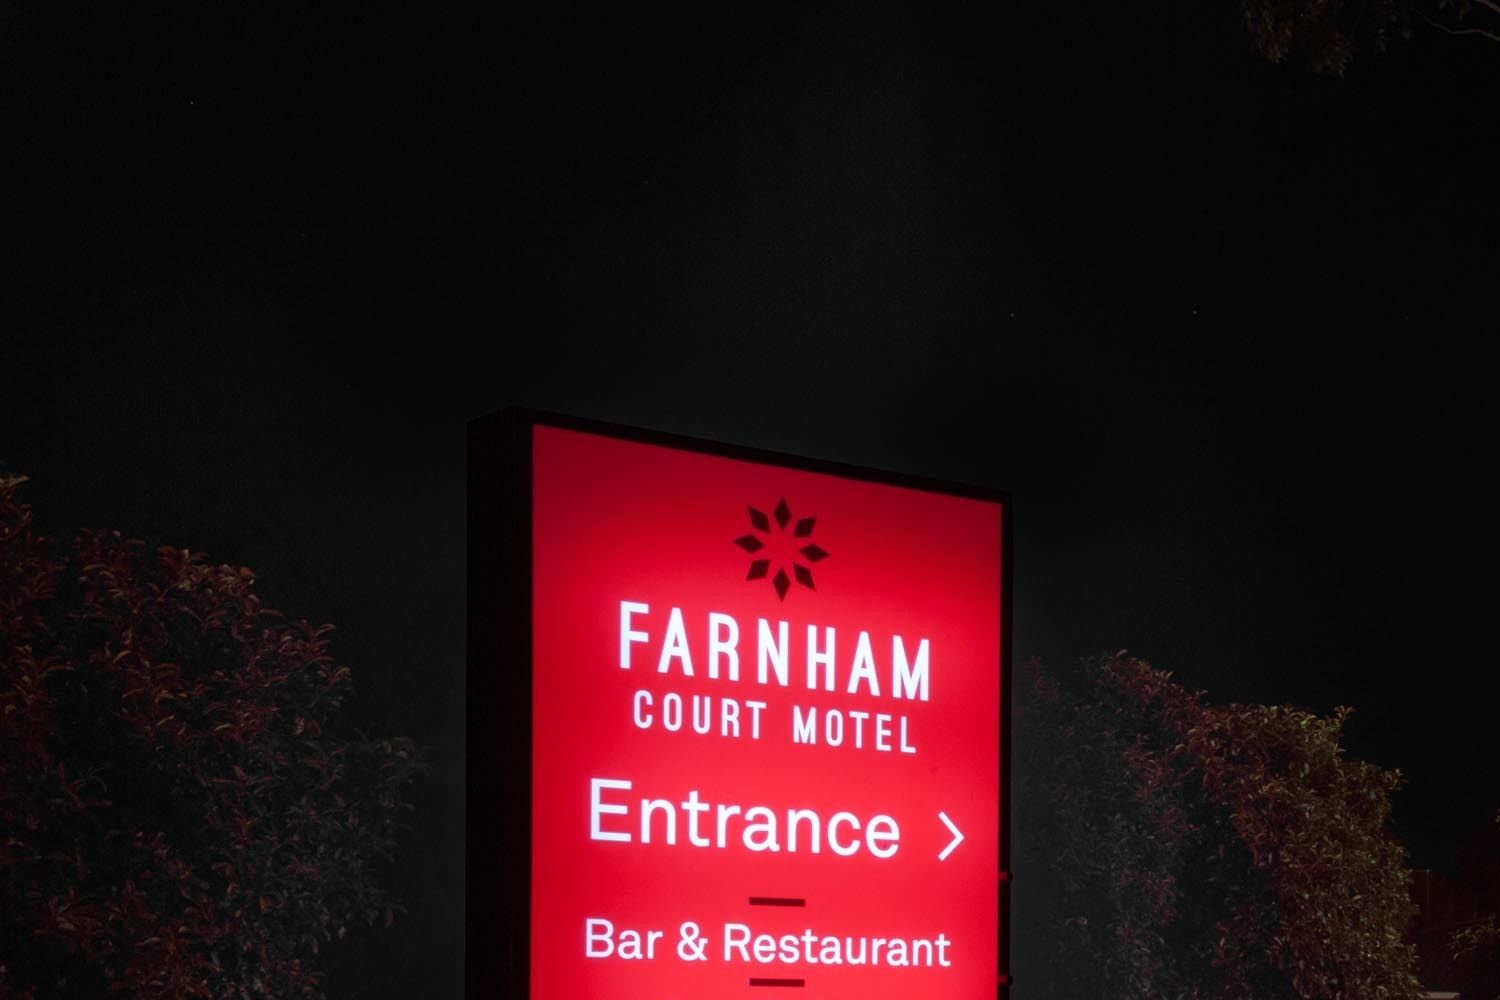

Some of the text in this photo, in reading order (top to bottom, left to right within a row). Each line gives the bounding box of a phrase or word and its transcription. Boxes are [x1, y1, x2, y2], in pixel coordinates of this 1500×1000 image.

[619, 600, 931, 702] FARNHAM
[633, 689, 917, 755] COURT MOTEL
[589, 777, 901, 860] Entrance
[585, 918, 952, 968] Bar & Restaurant
